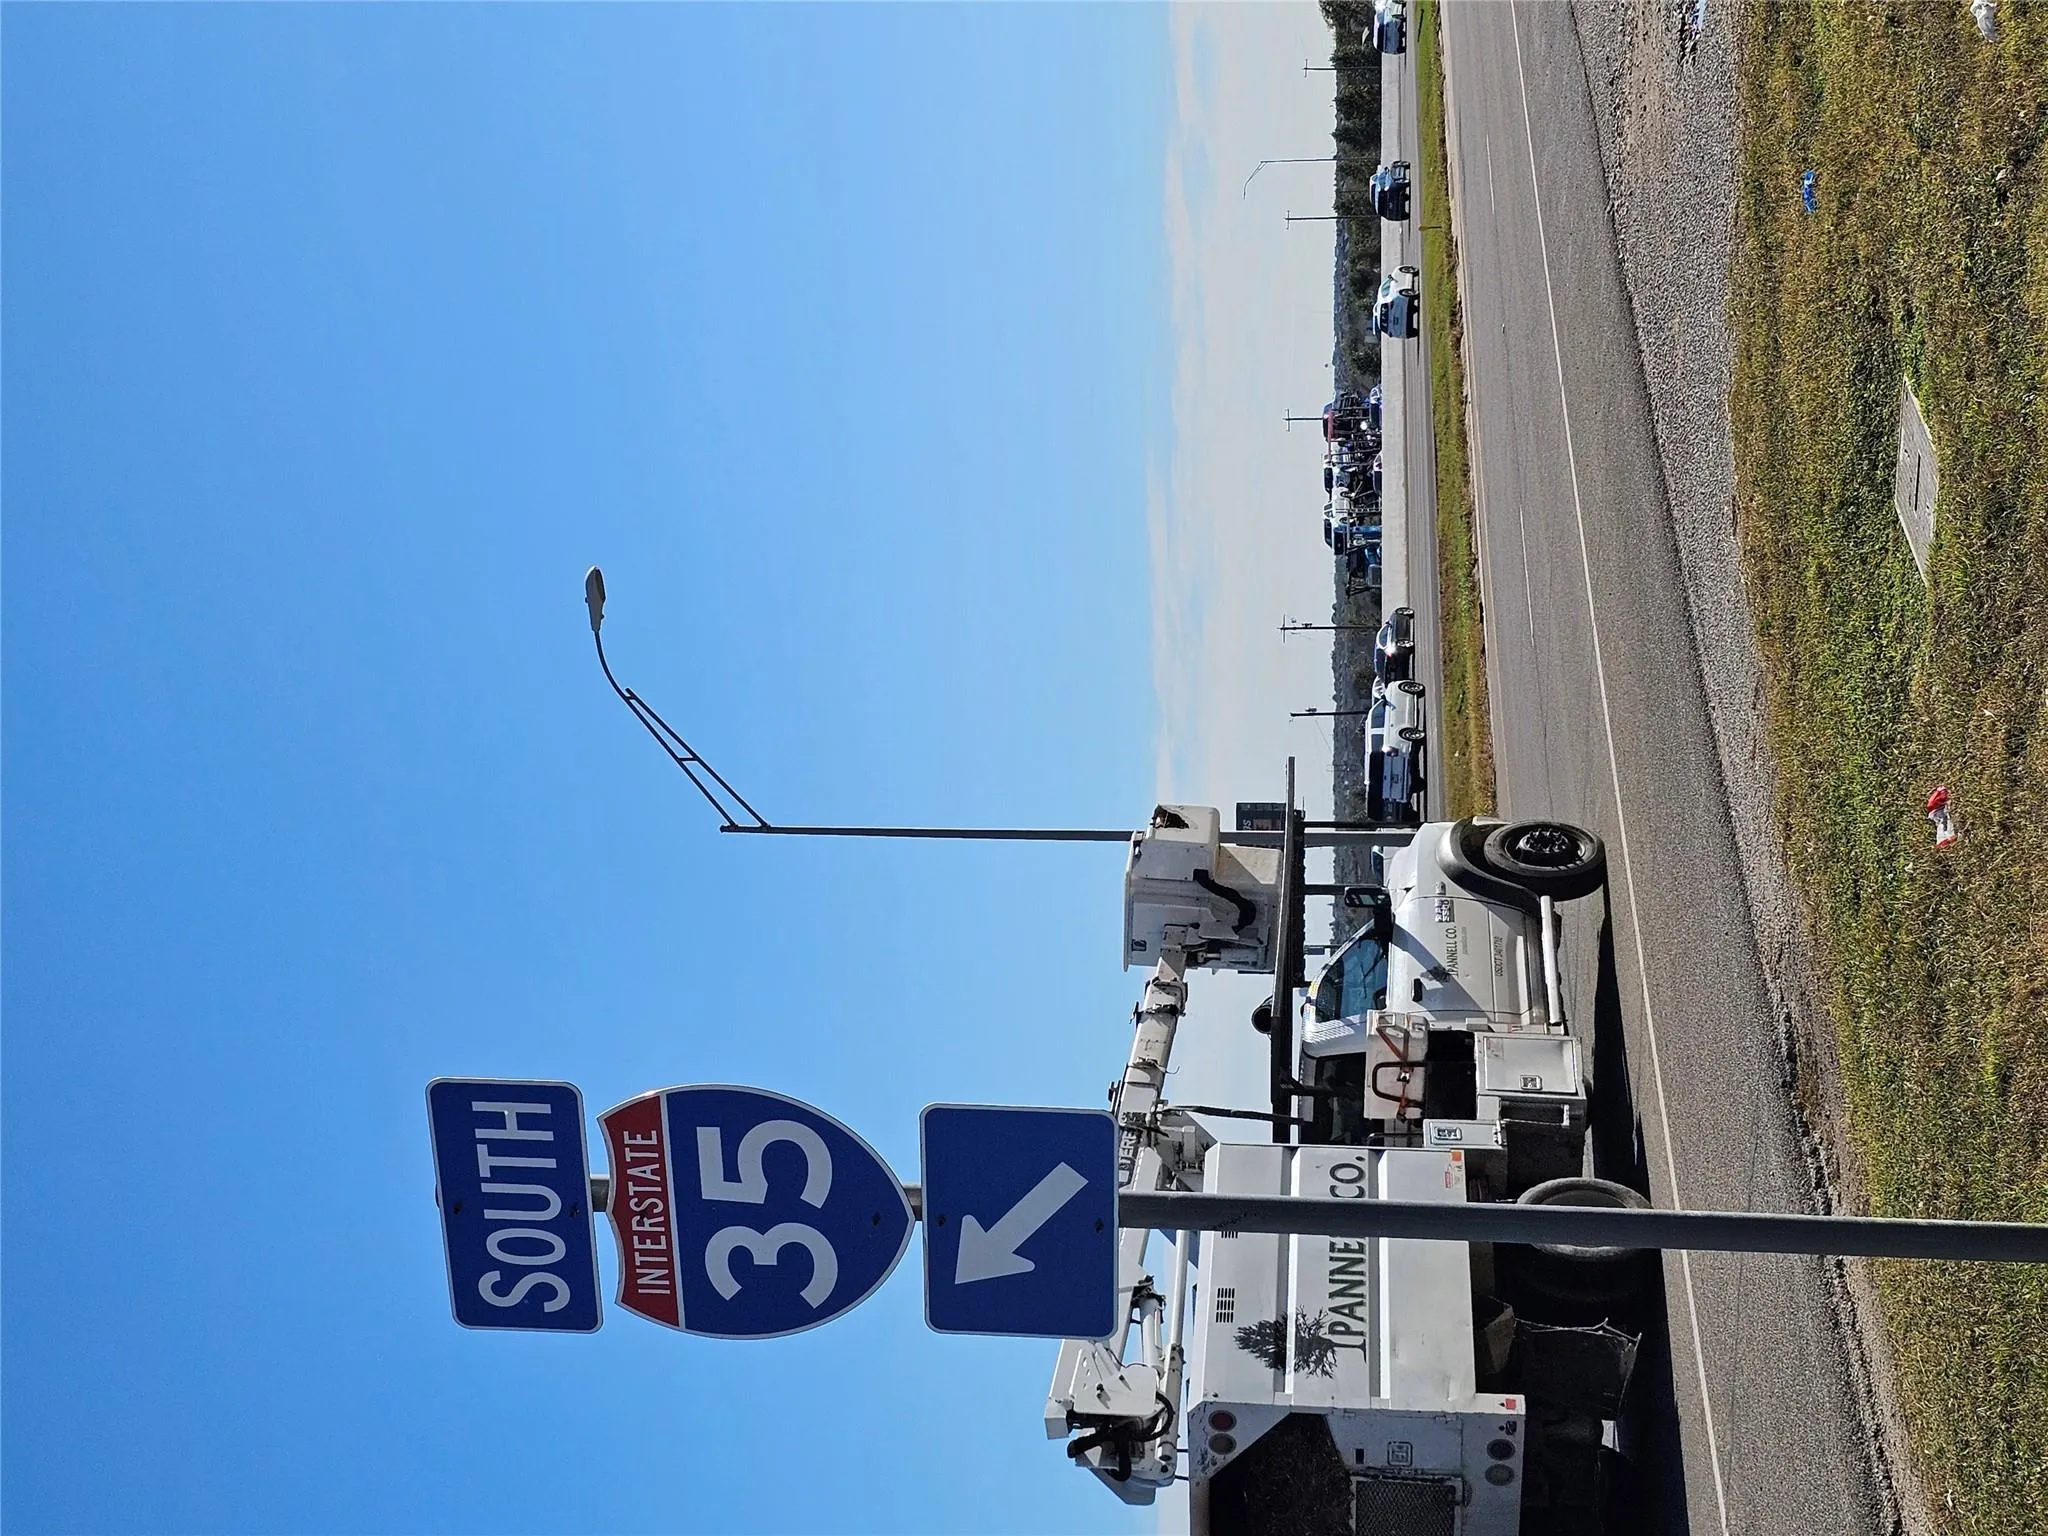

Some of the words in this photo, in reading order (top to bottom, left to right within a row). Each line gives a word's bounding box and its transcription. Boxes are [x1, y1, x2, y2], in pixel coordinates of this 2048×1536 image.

[1445, 926, 1457, 939] CO.
[1445, 941, 1459, 973] PANNELL
[472, 1101, 571, 1312] SOUTH
[622, 1130, 671, 1294] INTERSTATE
[696, 1119, 838, 1309] 35
[1329, 1156, 1366, 1199] CO.
[1327, 1236, 1367, 1337] PANNE
